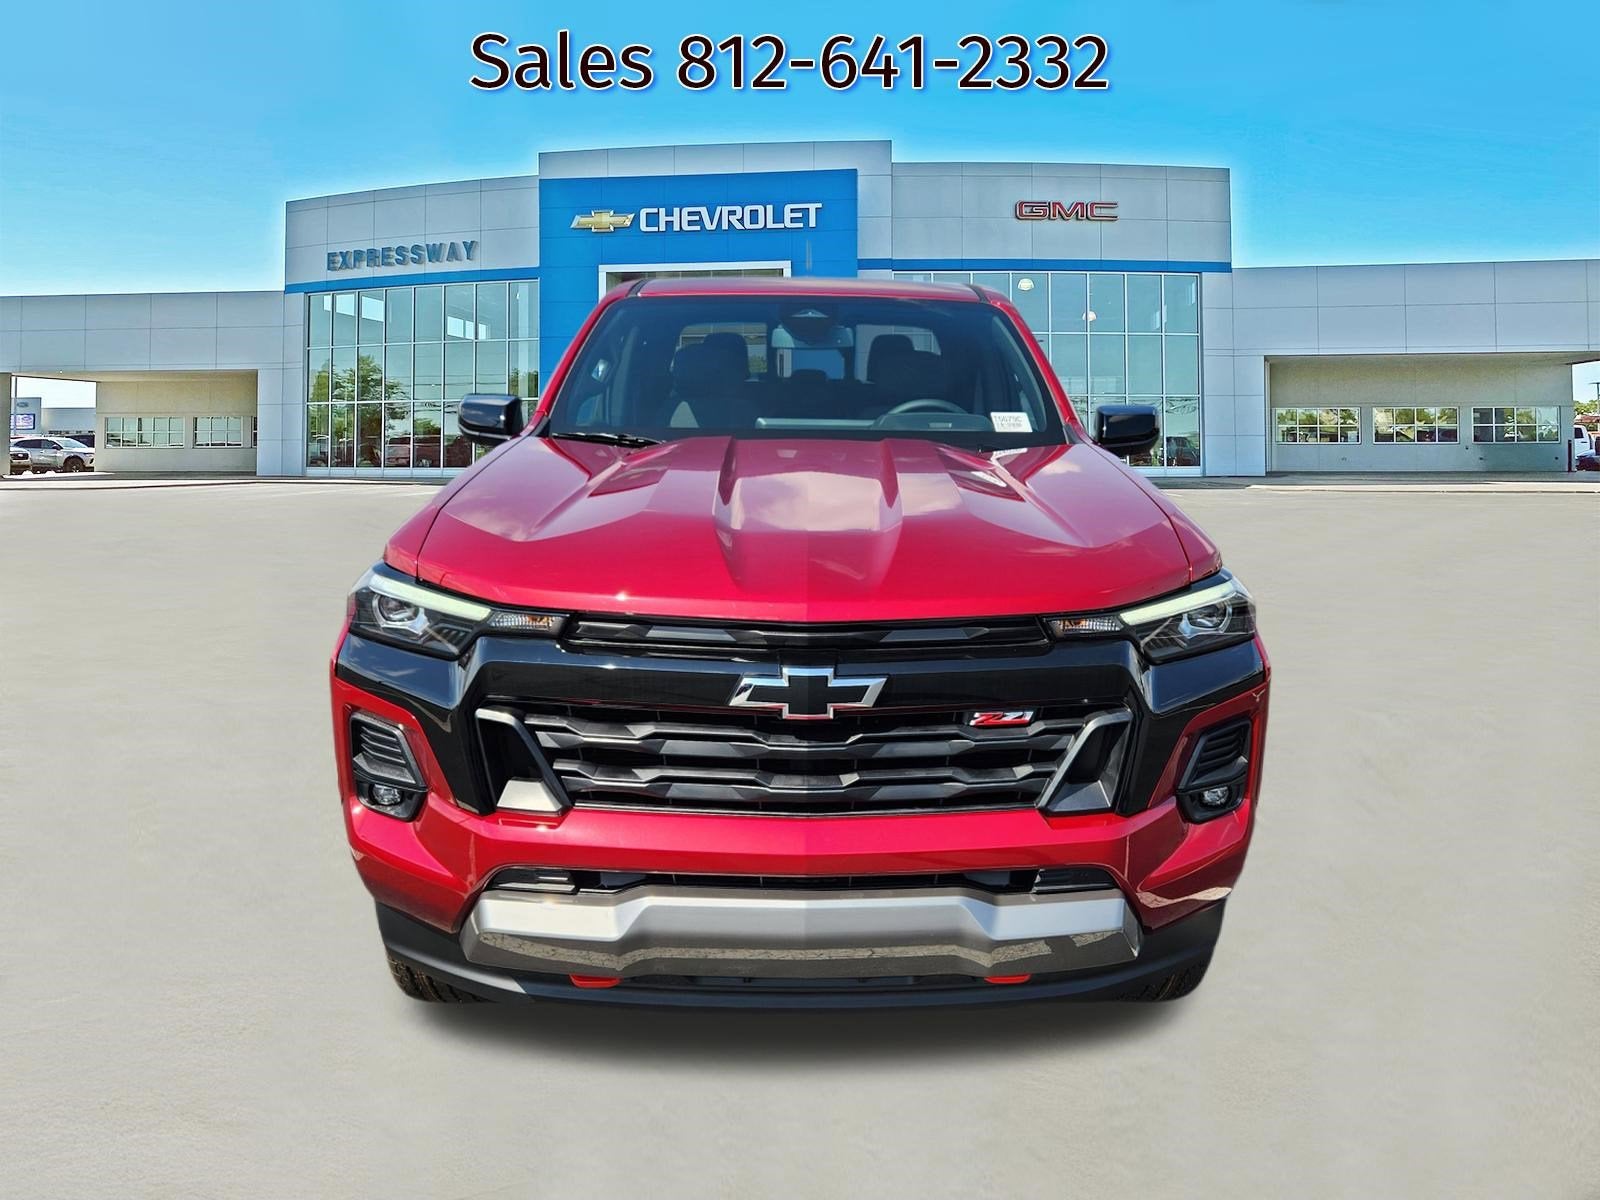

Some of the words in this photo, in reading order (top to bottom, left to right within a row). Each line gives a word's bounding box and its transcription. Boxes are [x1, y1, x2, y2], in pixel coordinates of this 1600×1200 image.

[639, 203, 823, 233] CHEVROLET
[1015, 200, 1120, 221] GMC
[327, 239, 479, 272] EXPRESSWAY
[969, 711, 1035, 728] Z71
